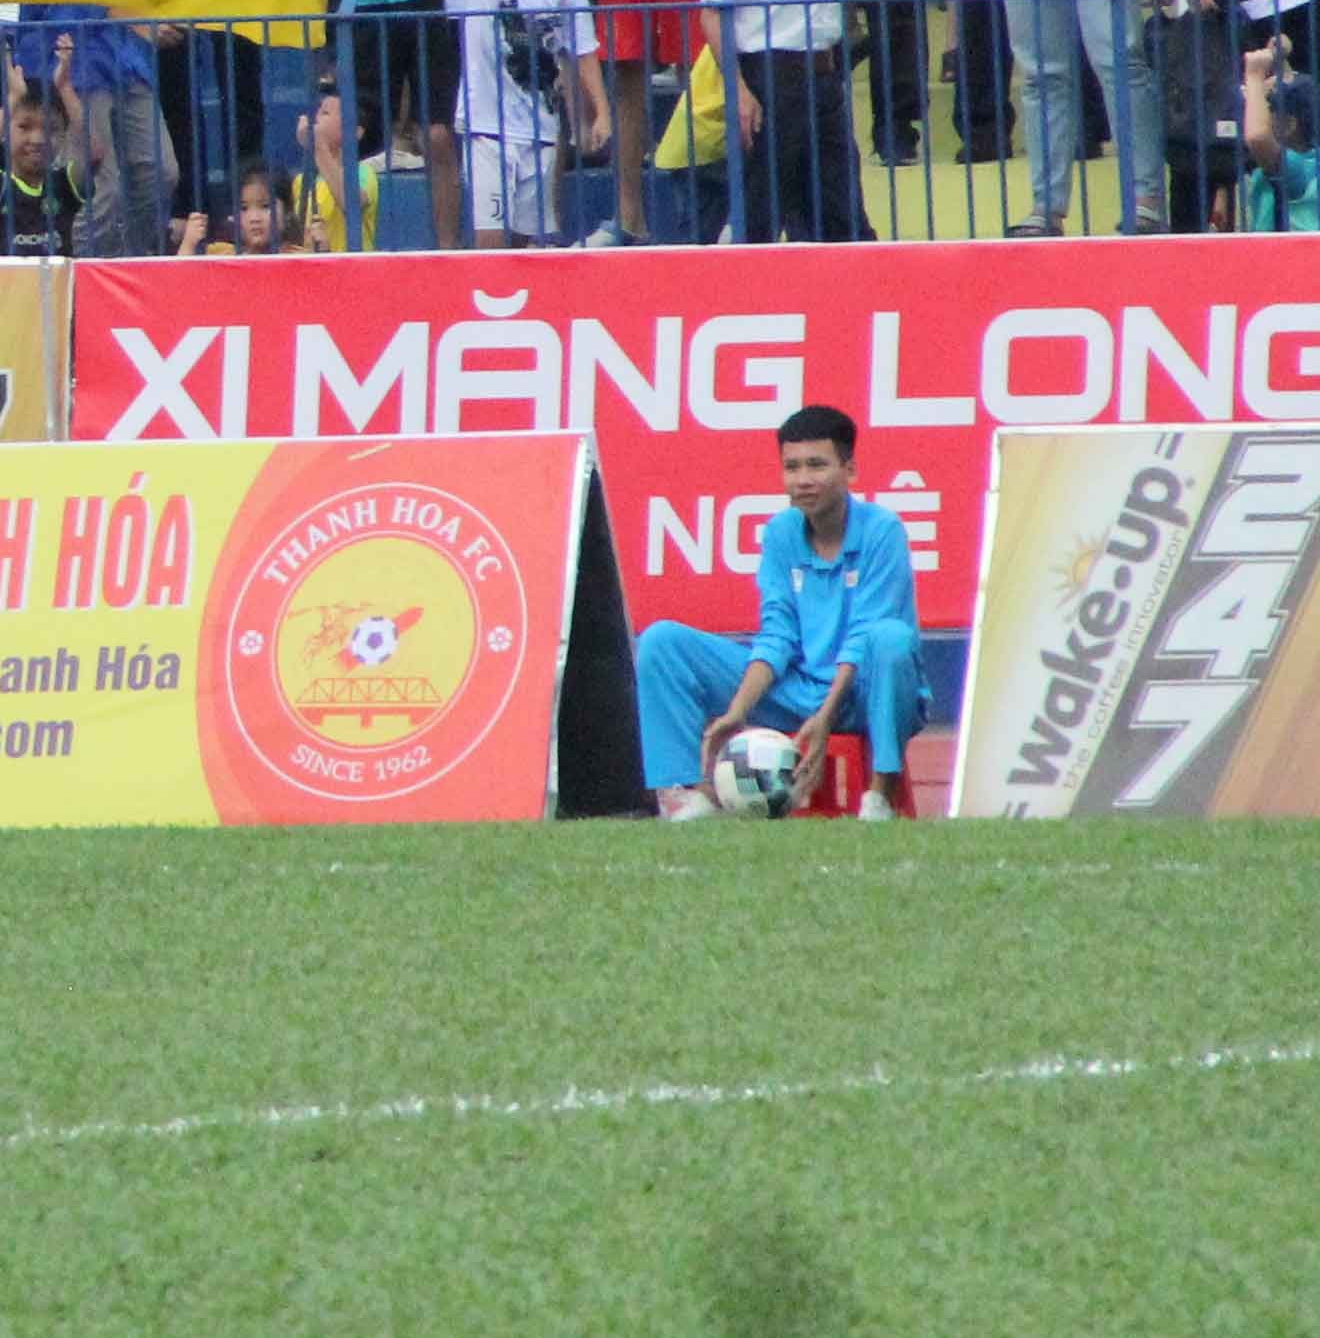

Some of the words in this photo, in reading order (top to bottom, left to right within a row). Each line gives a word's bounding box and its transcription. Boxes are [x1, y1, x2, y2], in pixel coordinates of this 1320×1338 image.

[105, 324, 252, 440] XI
[291, 288, 807, 437] MĂNG
[869, 302, 1320, 428] LONG
[53, 471, 191, 610] HÓA
[262, 495, 379, 589] THANH
[389, 495, 461, 541] HOA
[459, 533, 504, 583] FC
[94, 644, 180, 691] Hóa
[1005, 466, 1190, 786] wake-up
[290, 742, 365, 783] SINCE
[373, 742, 432, 781] 1962
